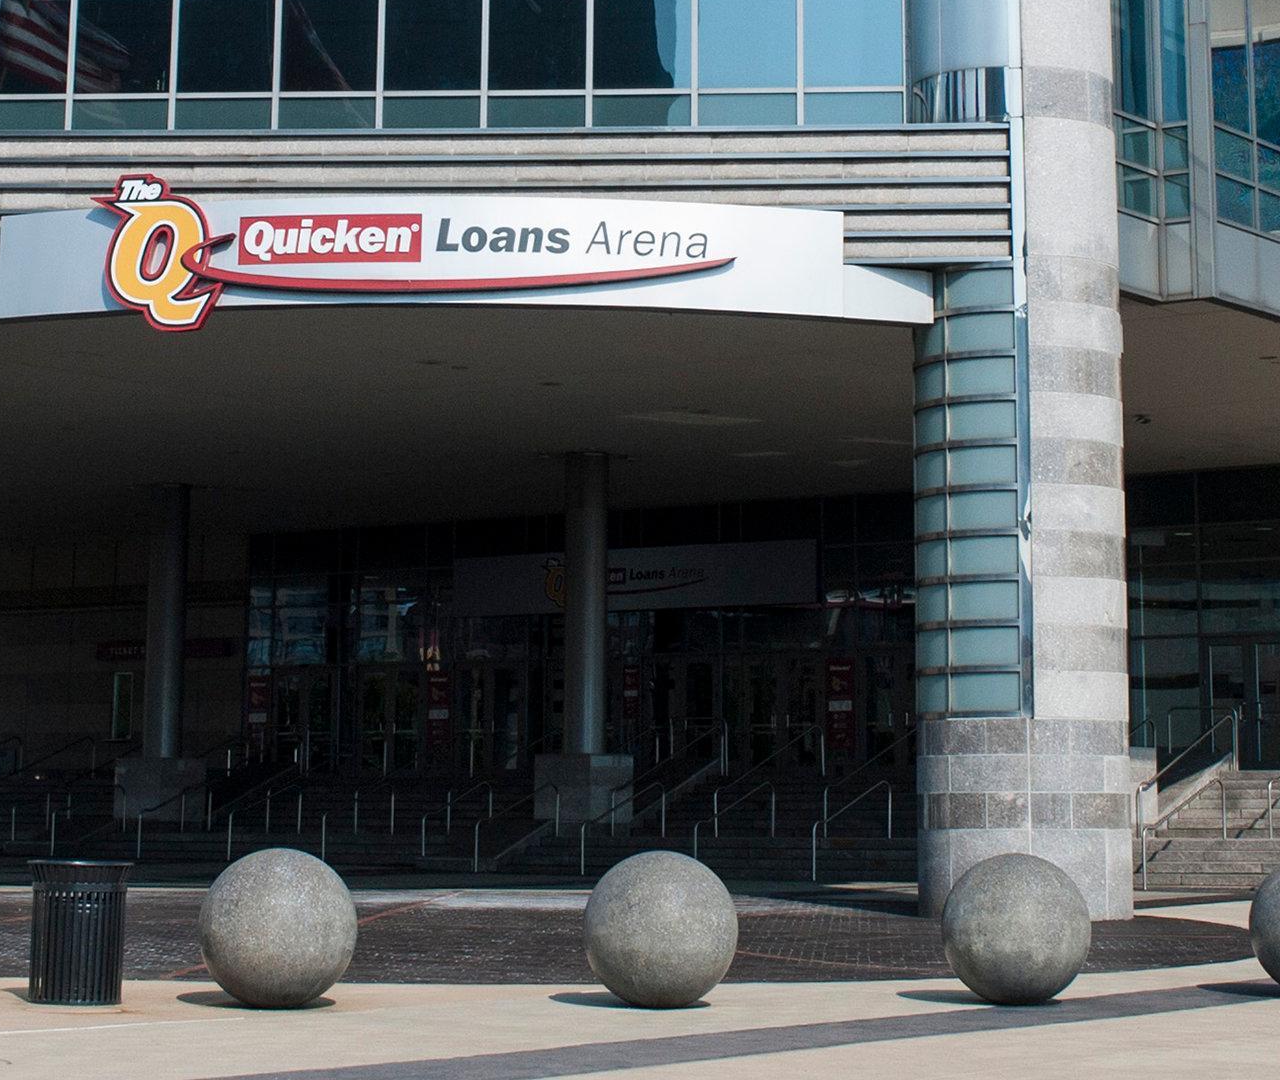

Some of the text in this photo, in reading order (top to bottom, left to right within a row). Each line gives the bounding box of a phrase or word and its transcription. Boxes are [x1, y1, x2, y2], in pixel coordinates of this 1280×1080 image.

[120, 179, 162, 201] The
[108, 199, 215, 327] Q
[436, 218, 570, 254] Loans
[585, 220, 708, 259] Arena
